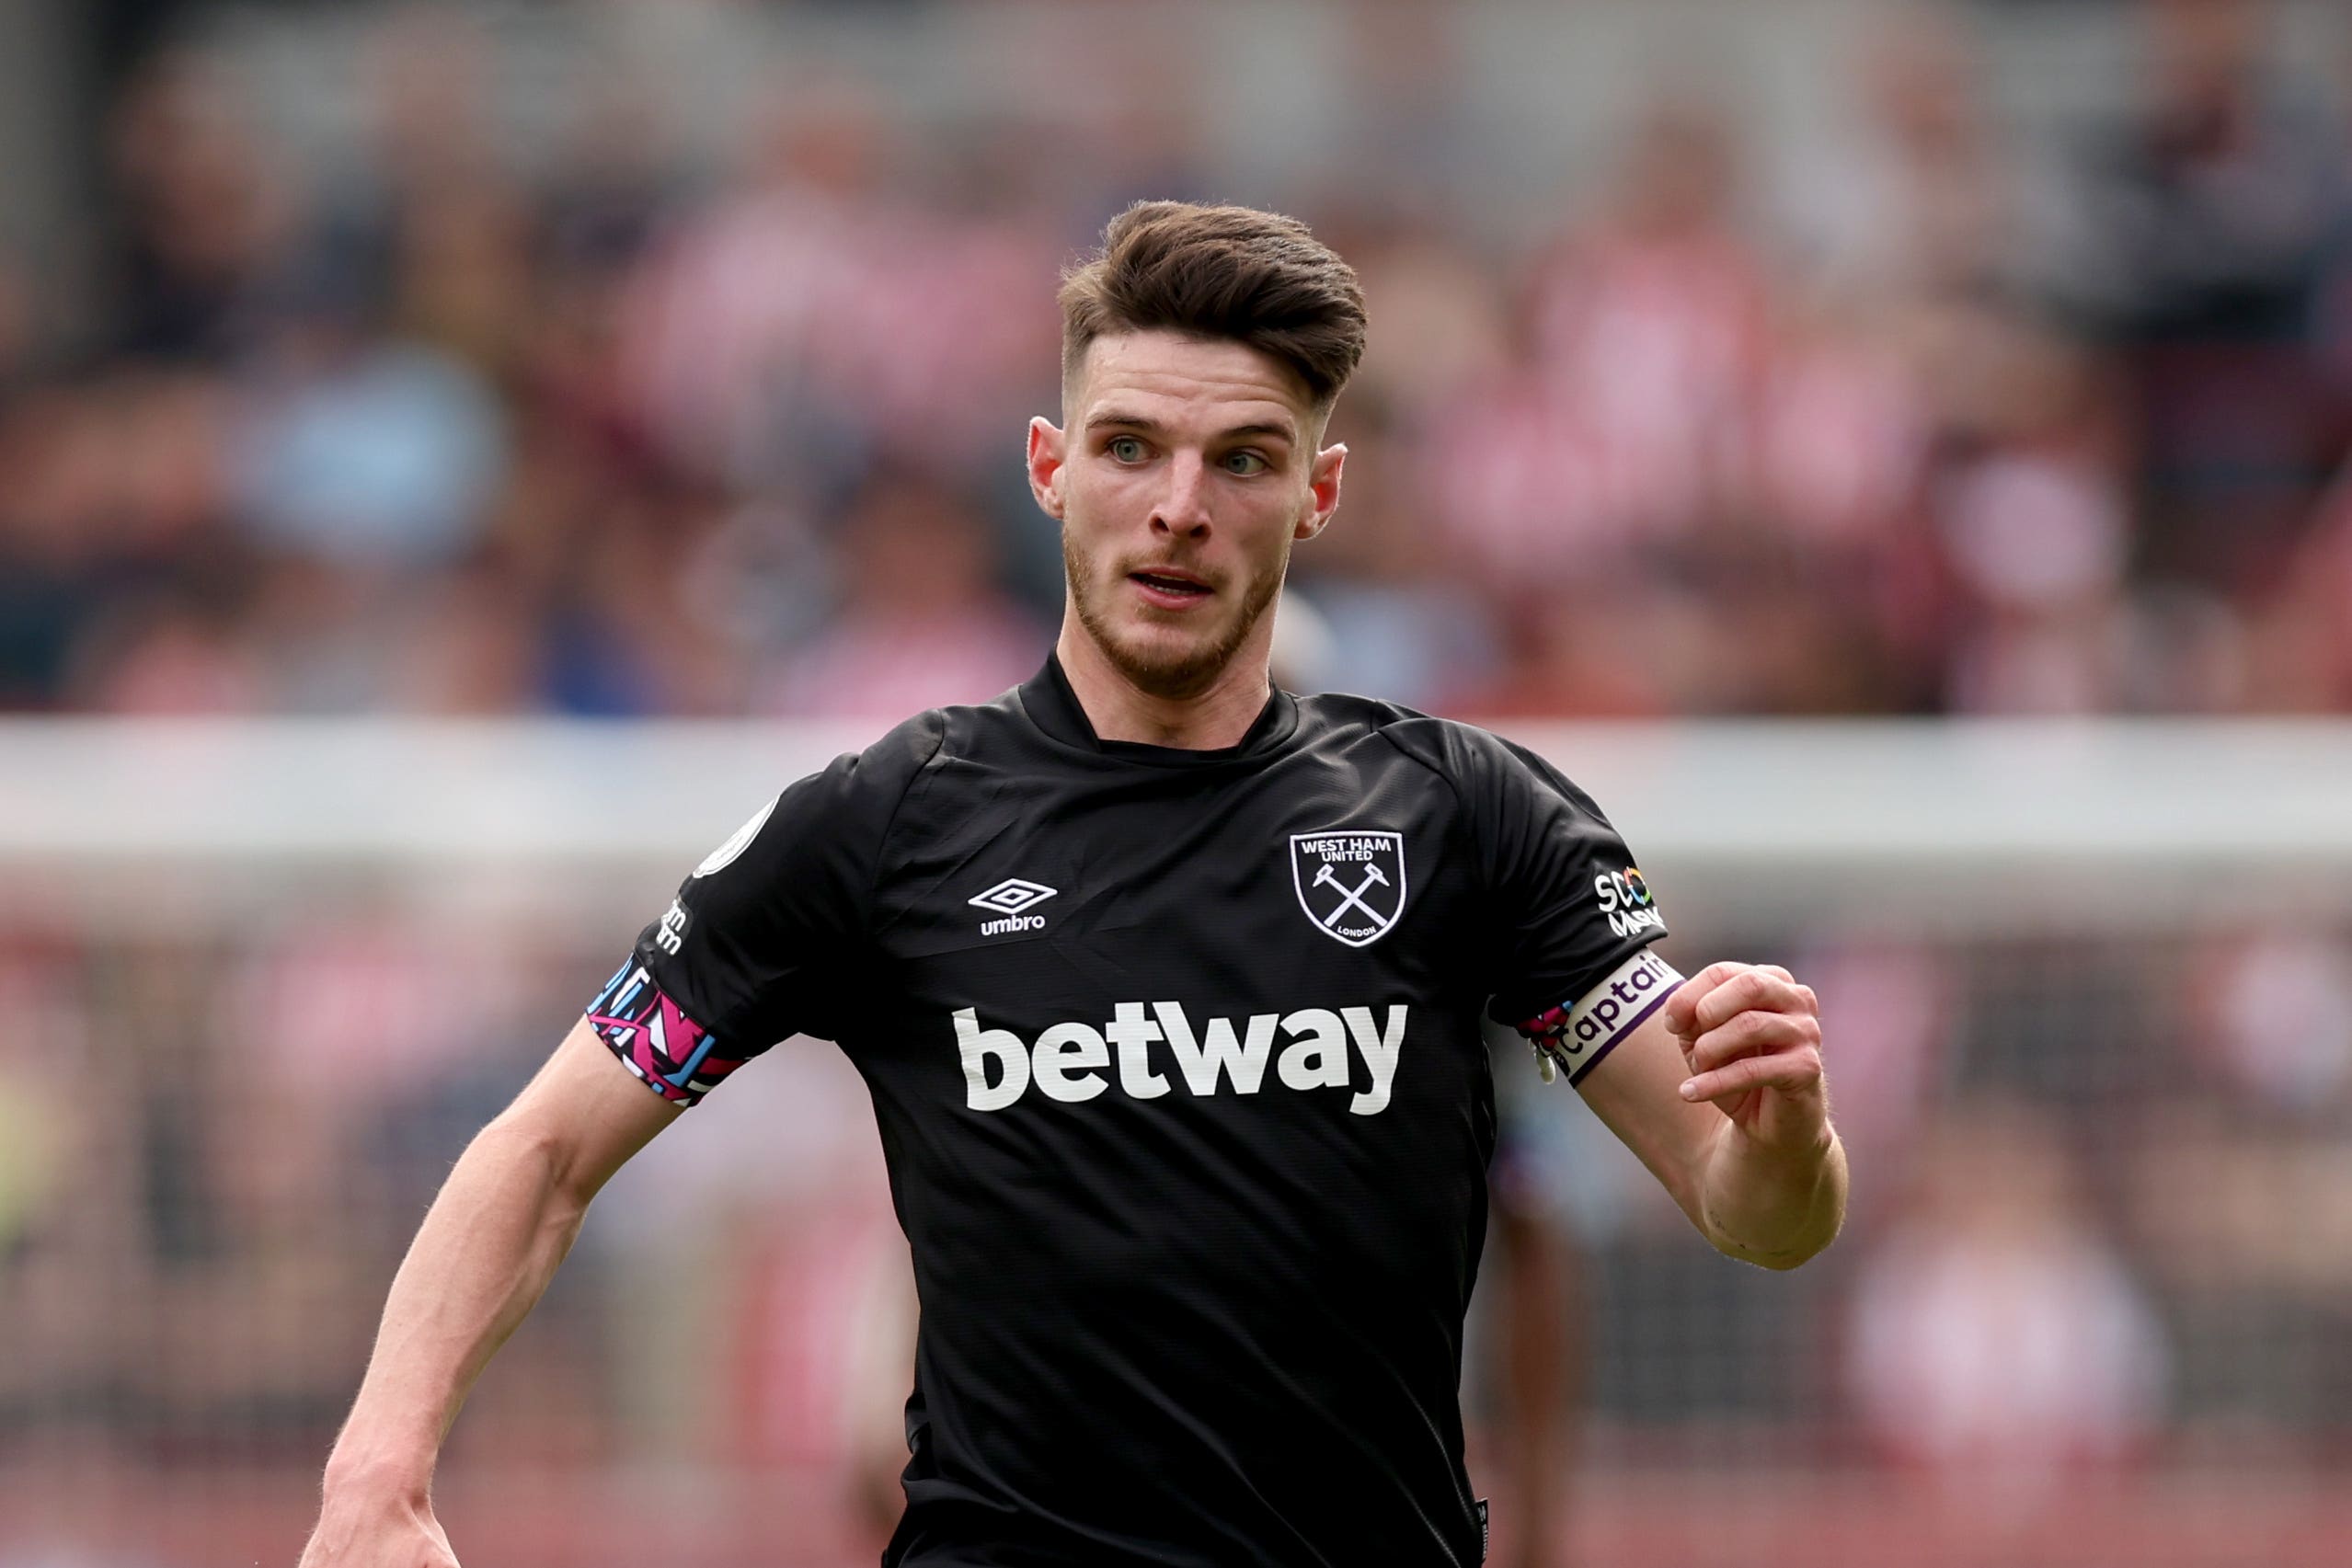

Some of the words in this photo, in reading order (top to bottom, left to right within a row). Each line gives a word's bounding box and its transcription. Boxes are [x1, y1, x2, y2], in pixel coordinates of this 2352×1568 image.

[1302, 839, 1346, 853] WEST
[1349, 838, 1392, 852] HAM
[1321, 851, 1373, 862] UNITED
[981, 914, 1046, 936] umbro
[1337, 925, 1377, 937] LONDON
[951, 1001, 1409, 1116] betway
